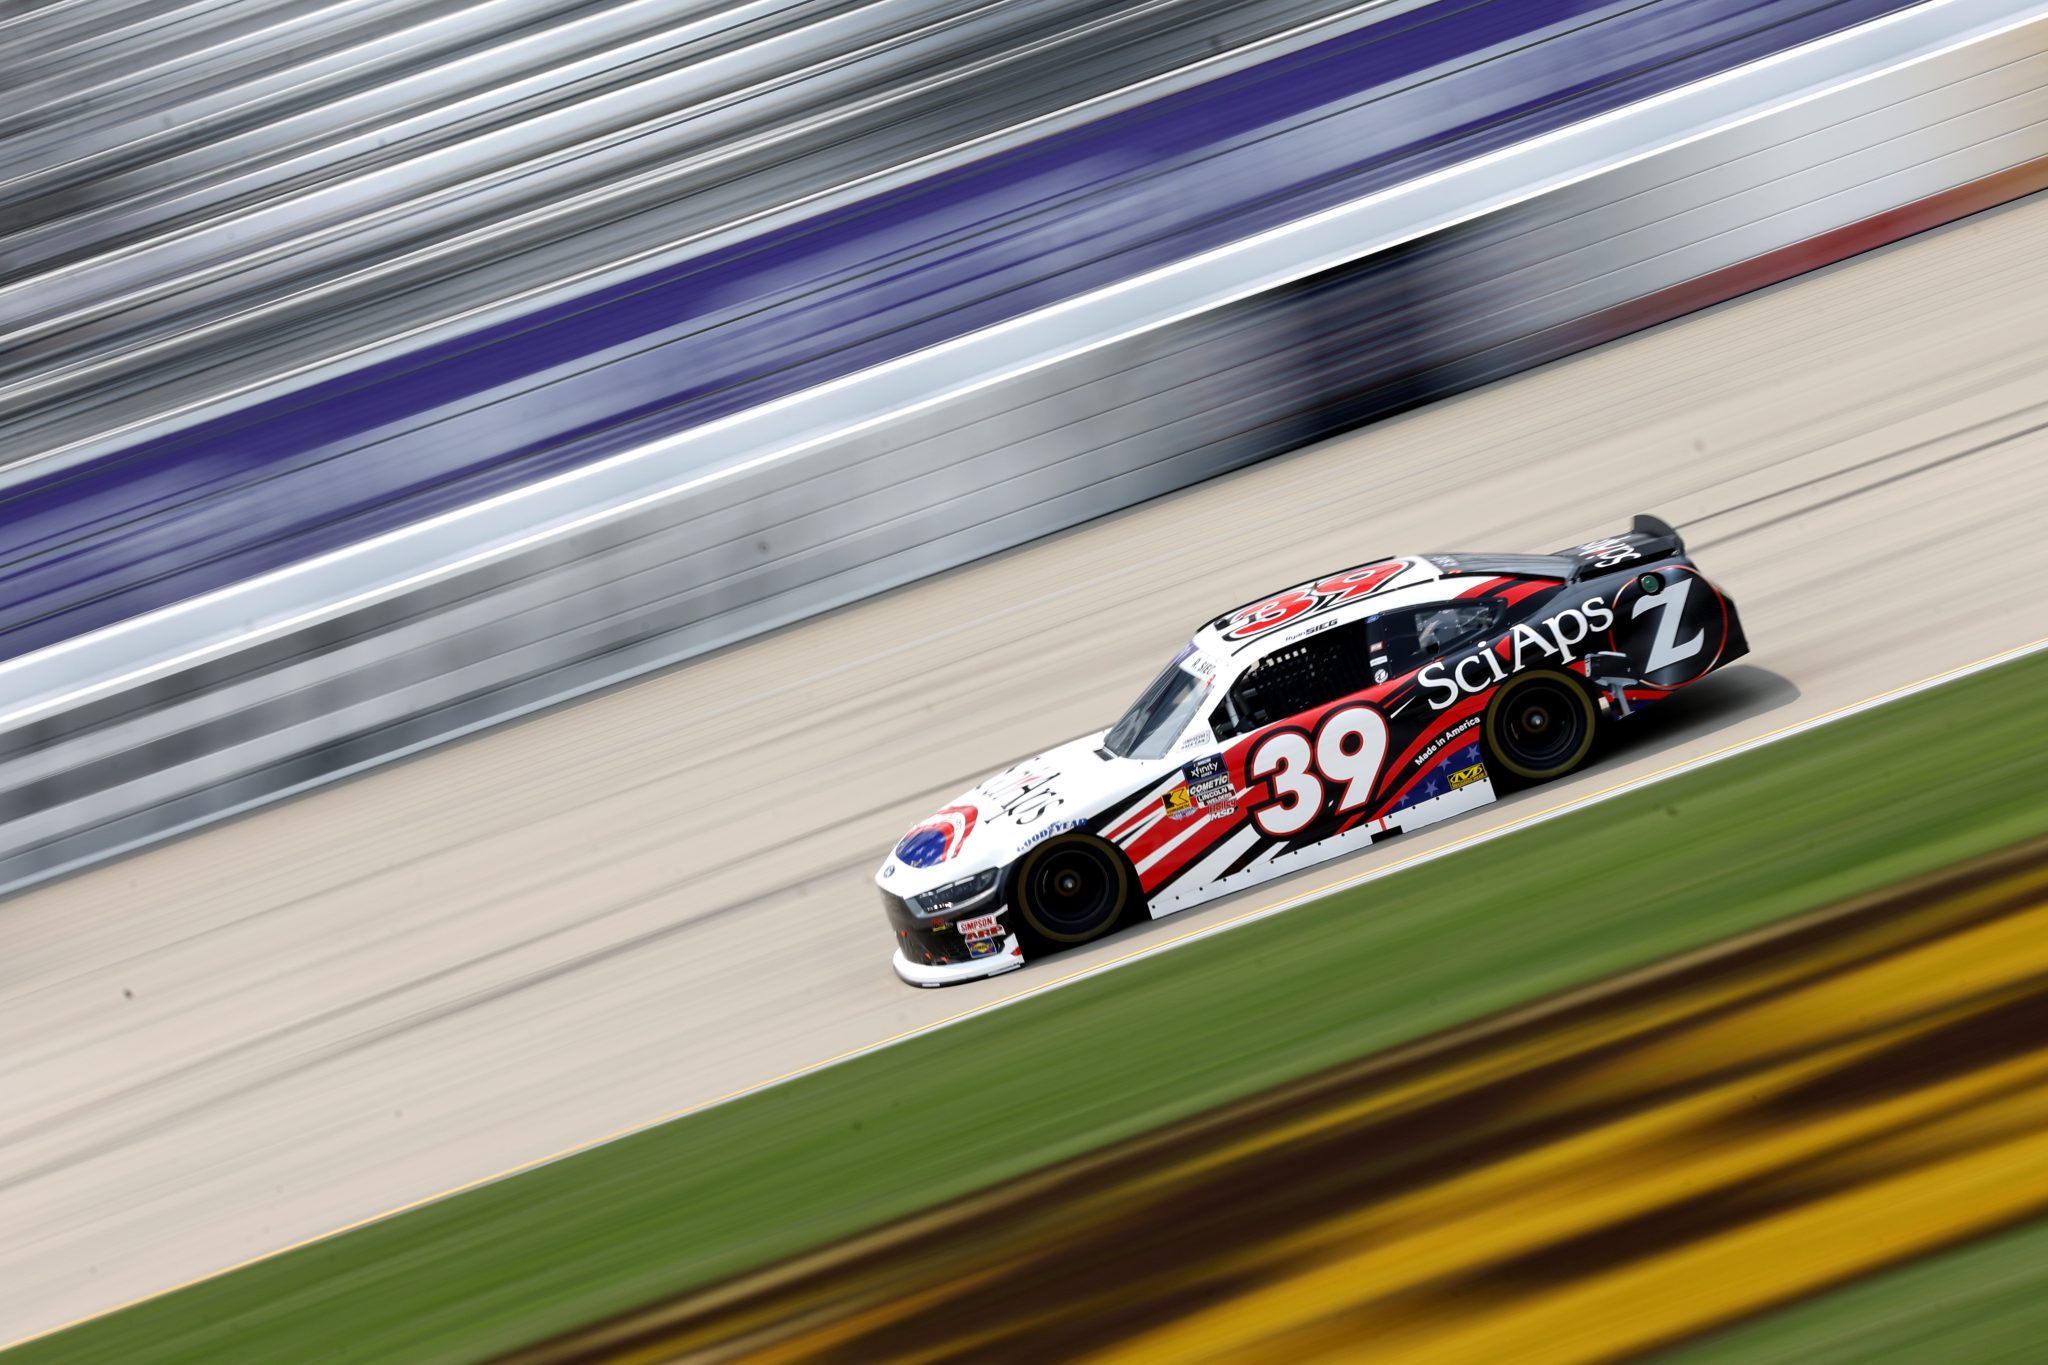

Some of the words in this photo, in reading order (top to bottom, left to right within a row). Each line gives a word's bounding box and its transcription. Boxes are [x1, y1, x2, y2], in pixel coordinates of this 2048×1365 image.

[1227, 561, 1409, 638] 39
[1304, 618, 1339, 636] SIEG
[1417, 596, 1614, 710] SciAps
[1414, 744, 1438, 766] Made
[1435, 737, 1446, 748] in
[1445, 716, 1481, 741] America
[1190, 761, 1219, 778] xfinity
[1250, 705, 1390, 837] 39
[1189, 775, 1229, 795] COMETIC
[1197, 786, 1228, 803] LINCOLN
[1209, 807, 1237, 821] MSD
[960, 916, 993, 933] SIMPSON
[965, 925, 1003, 941] ARP
